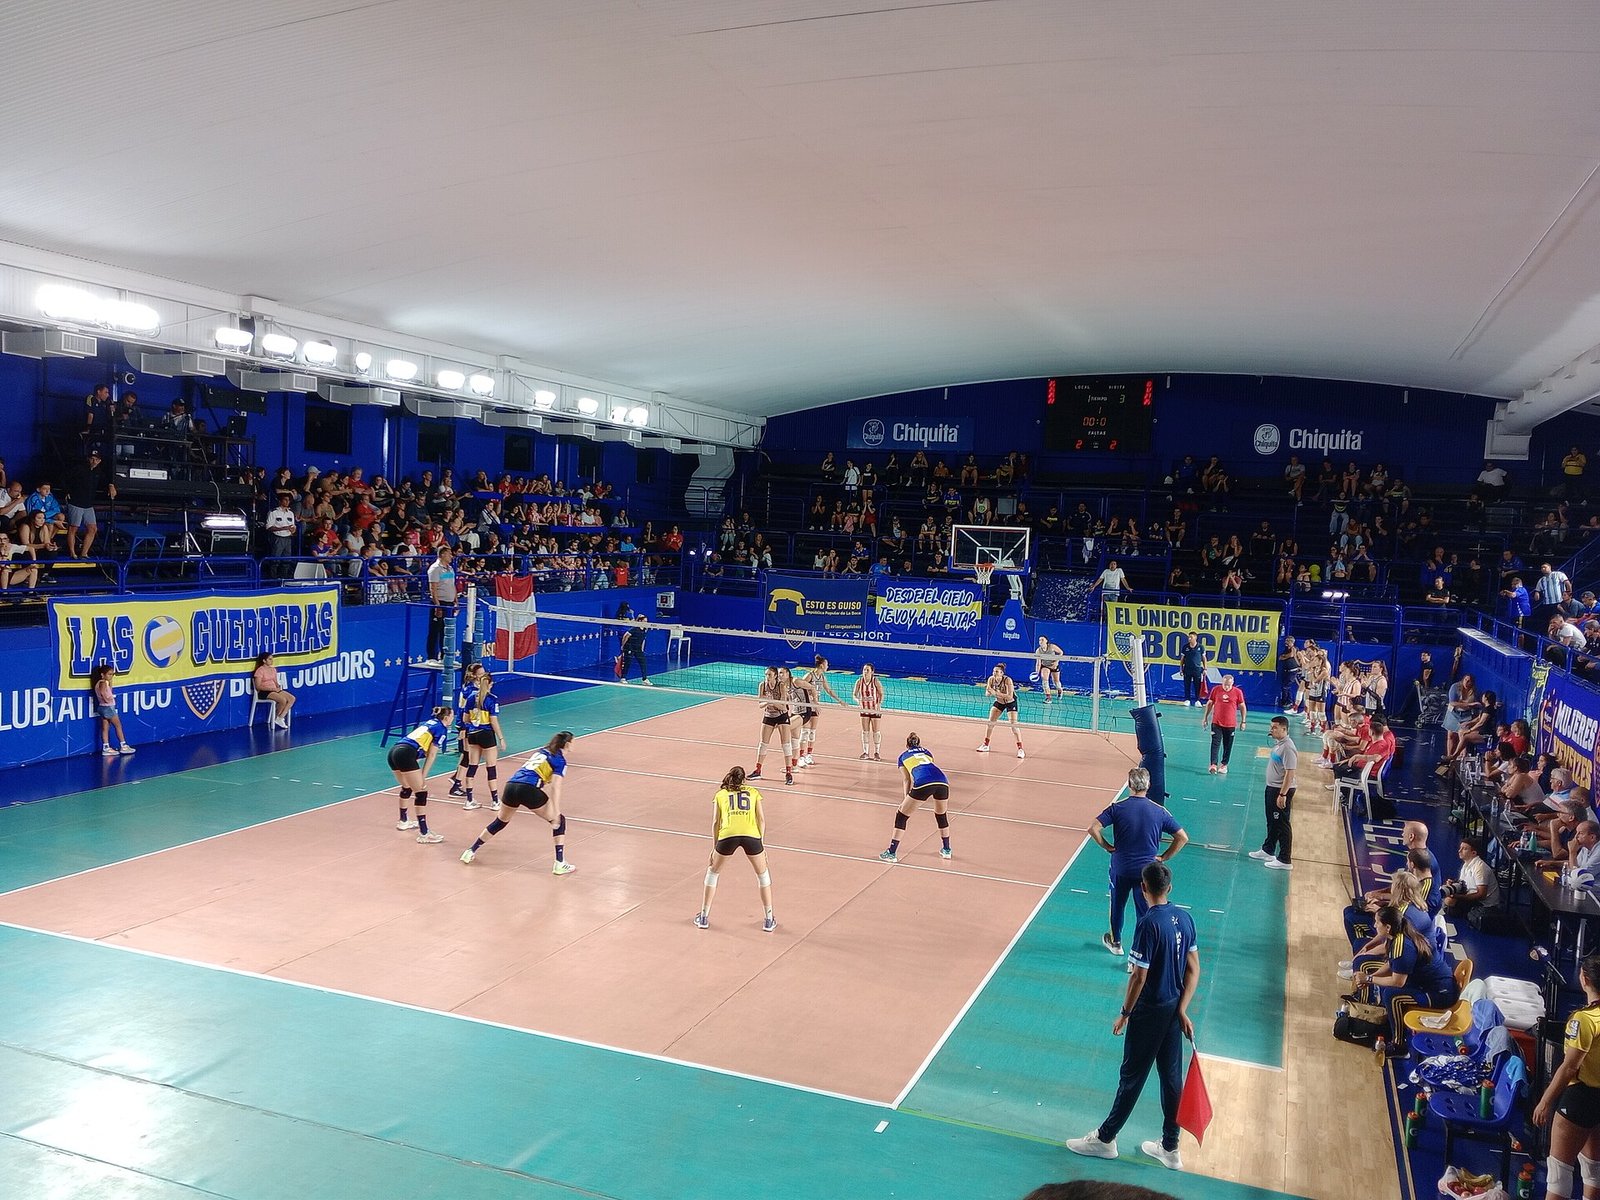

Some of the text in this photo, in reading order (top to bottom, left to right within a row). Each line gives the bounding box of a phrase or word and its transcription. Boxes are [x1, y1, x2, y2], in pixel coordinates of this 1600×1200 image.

[892, 422, 959, 448] Chiquita
[1289, 428, 1362, 456] Chiquita
[805, 600, 861, 610] ESTO ES GUISO
[886, 586, 975, 607] DESDE EL CIELO
[878, 605, 977, 632] TE VOY A ALENTAR
[1115, 605, 1271, 633] EL ÚNICO GRANDE
[67, 601, 333, 677] LAS GUERRERAS
[1141, 630, 1241, 664] BOCA
[0, 687, 51, 731] LUB
[292, 649, 375, 688] JUNIORS
[1555, 700, 1598, 752] MUJERES
[728, 790, 751, 811] 16
